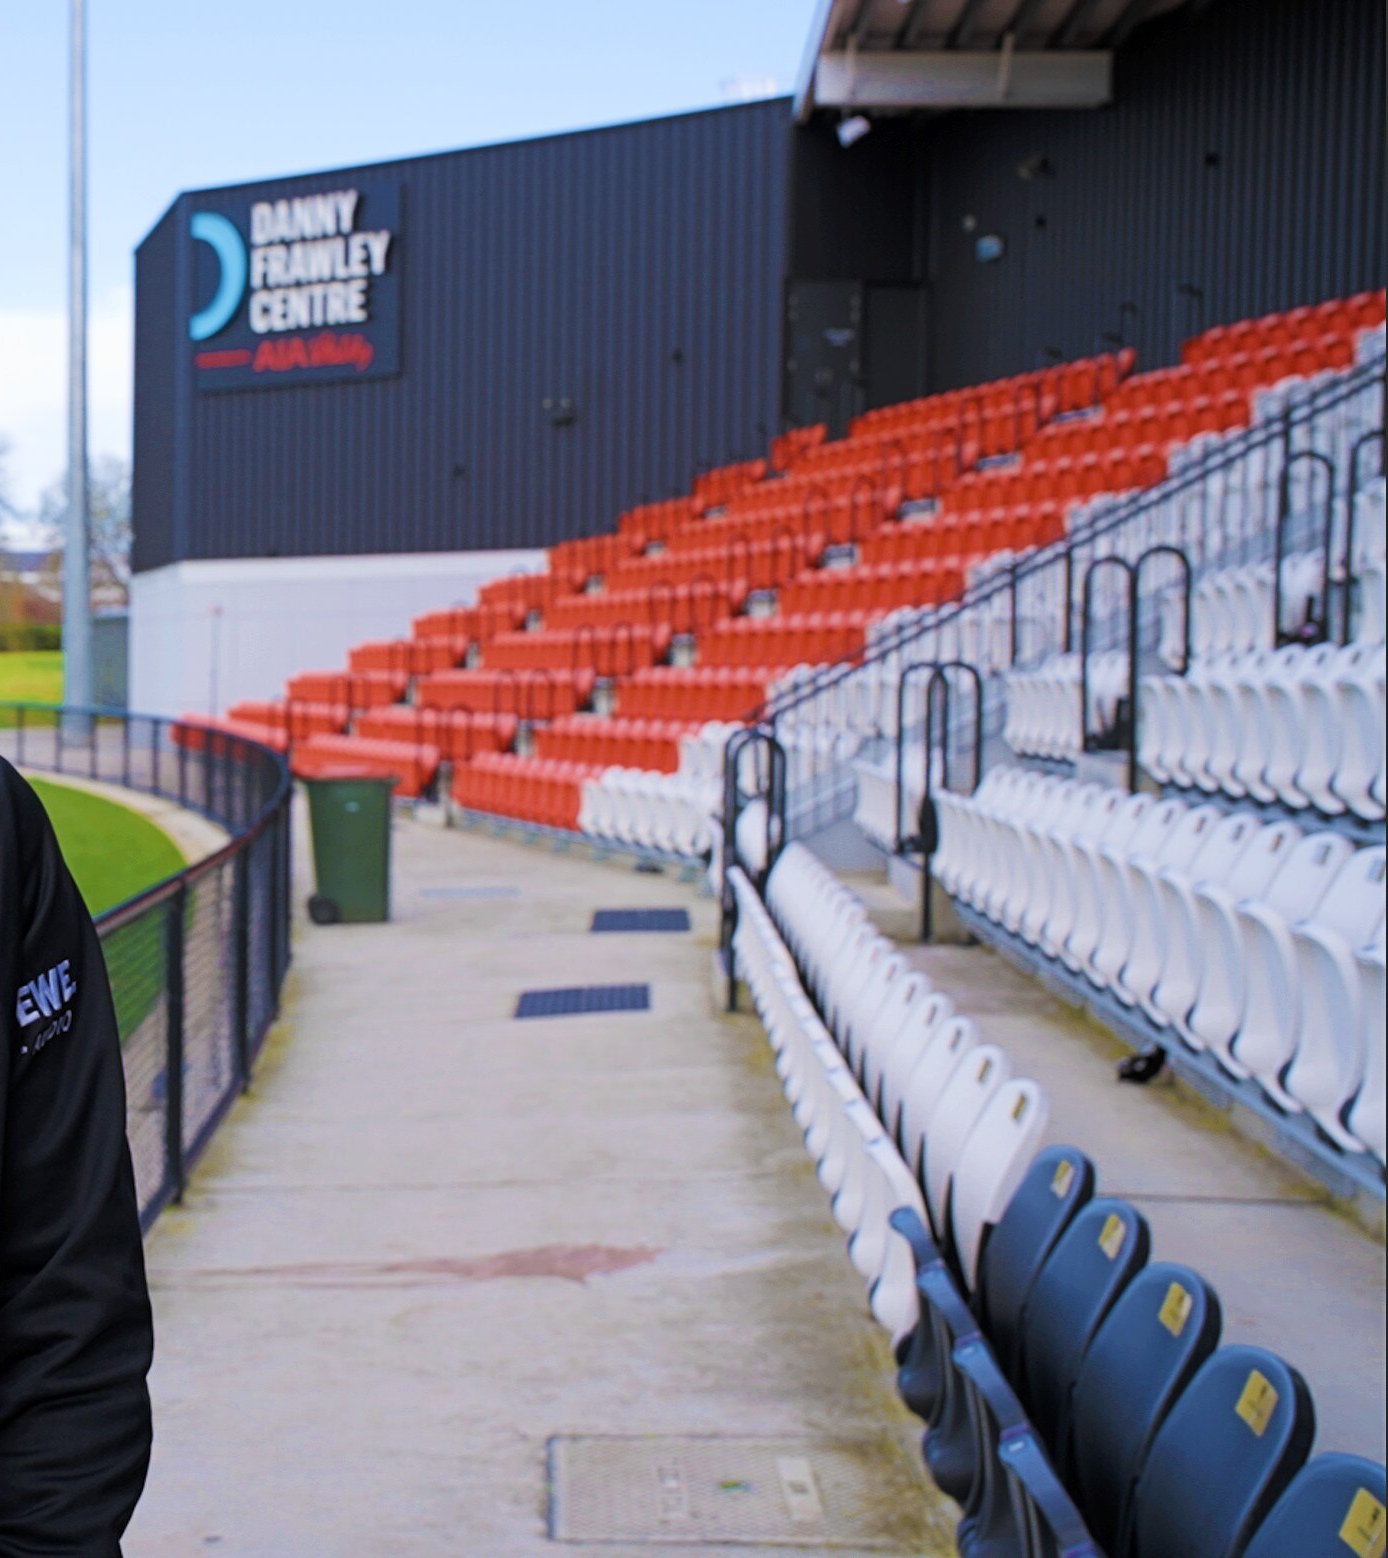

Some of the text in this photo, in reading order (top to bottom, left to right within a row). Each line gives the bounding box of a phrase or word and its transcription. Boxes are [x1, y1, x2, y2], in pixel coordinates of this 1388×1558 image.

[250, 188, 358, 247] DANNY
[250, 229, 391, 289] FRAWLEY
[249, 277, 368, 334] CENTRE
[16, 959, 76, 1027] EWE
